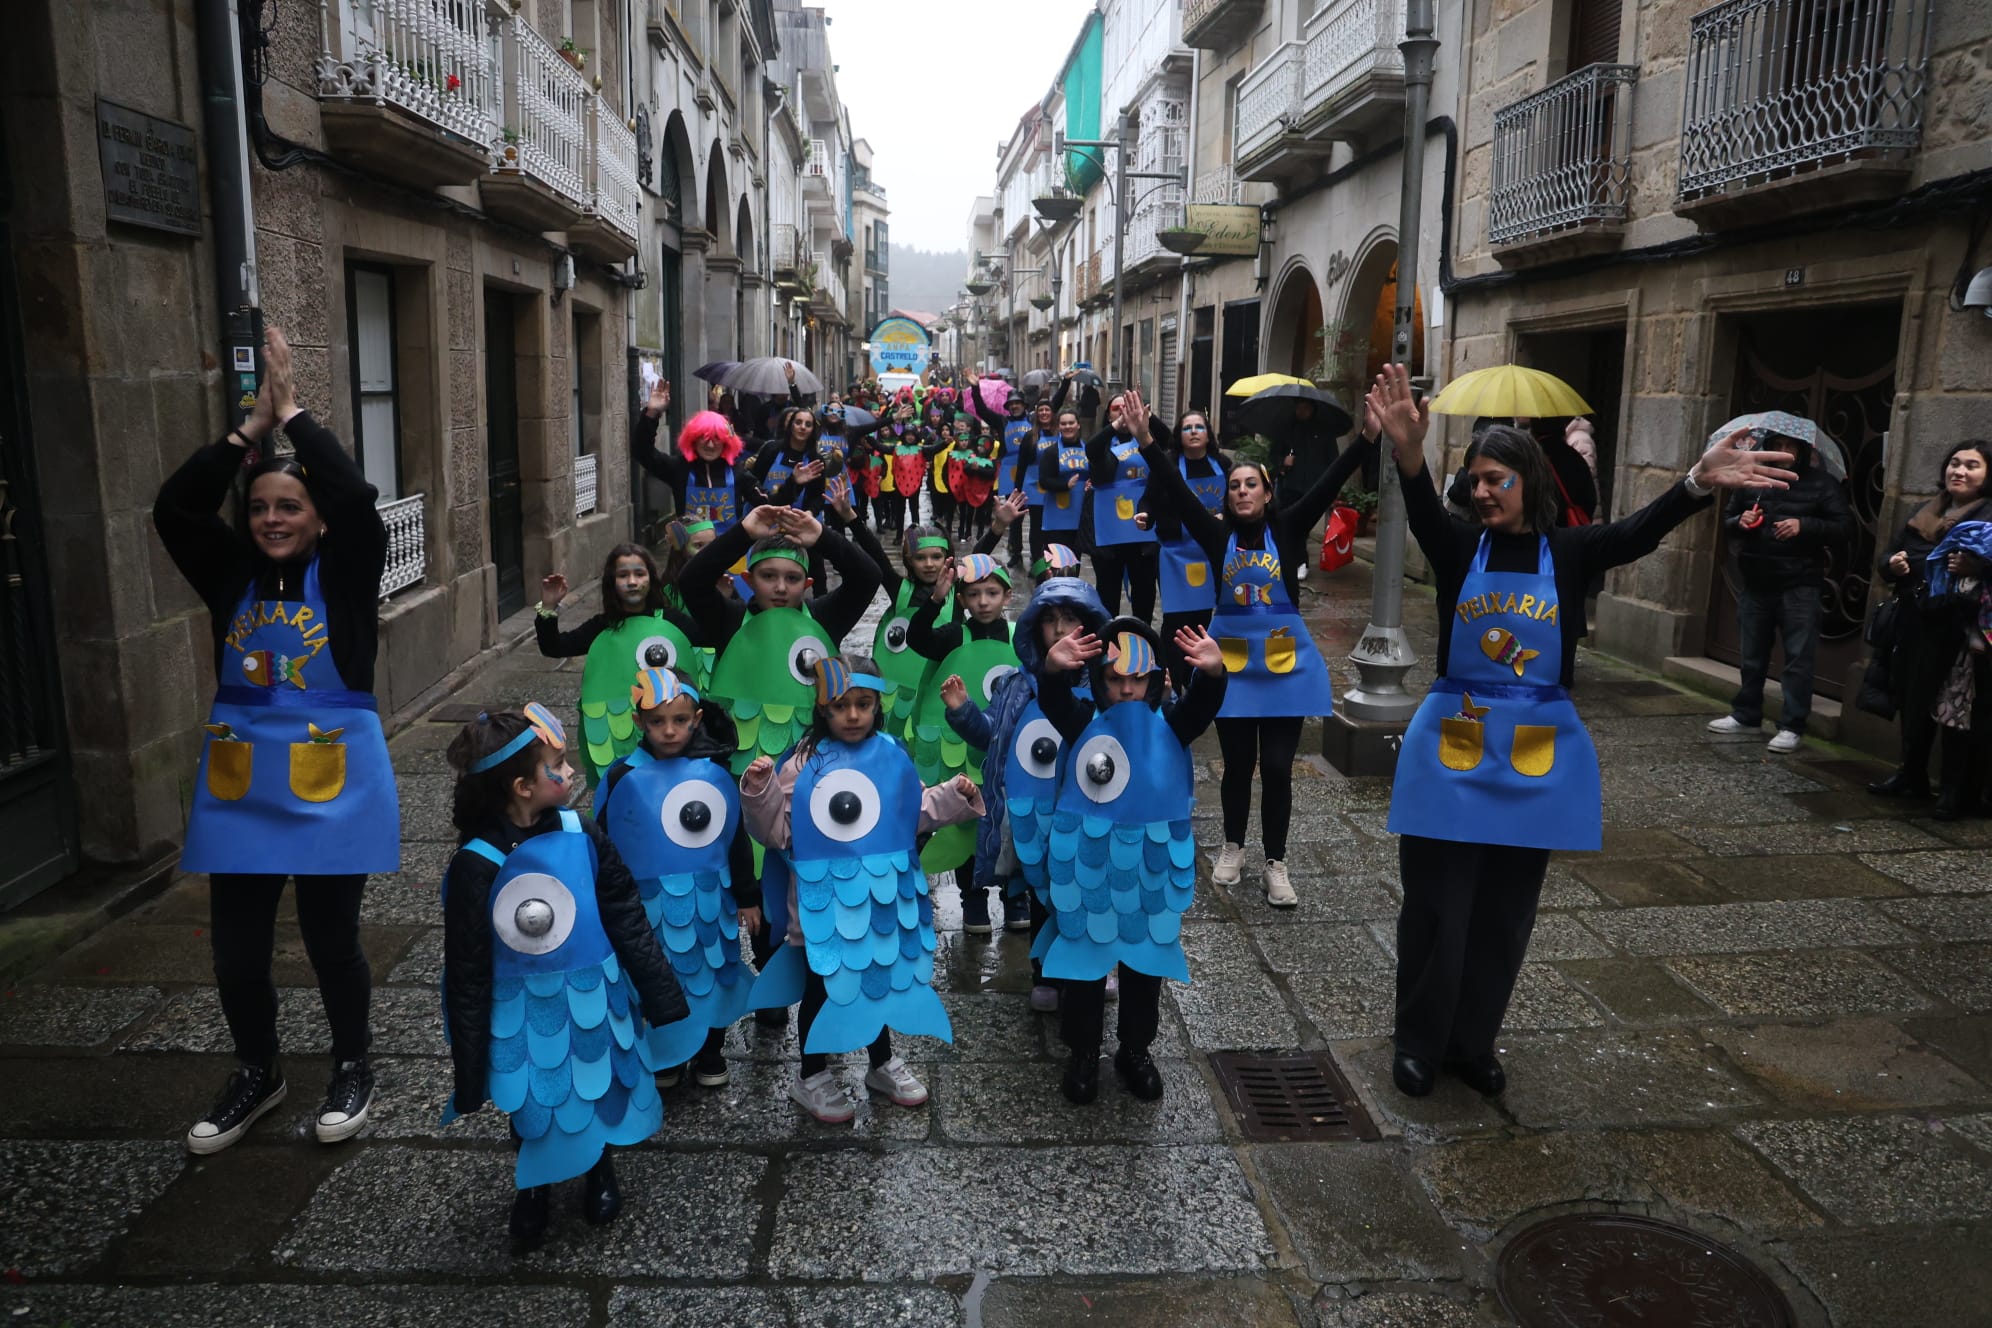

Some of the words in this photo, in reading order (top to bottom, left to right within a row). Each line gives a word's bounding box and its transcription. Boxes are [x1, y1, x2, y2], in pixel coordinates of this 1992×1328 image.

[1206, 221, 1241, 240] Eden
[1786, 270, 1800, 284] 48
[880, 351, 918, 361] CASTRELO
[1222, 551, 1281, 588] PEIXARIA
[1456, 591, 1559, 627] PEIXARIA
[225, 600, 329, 657] PEIXARIA
